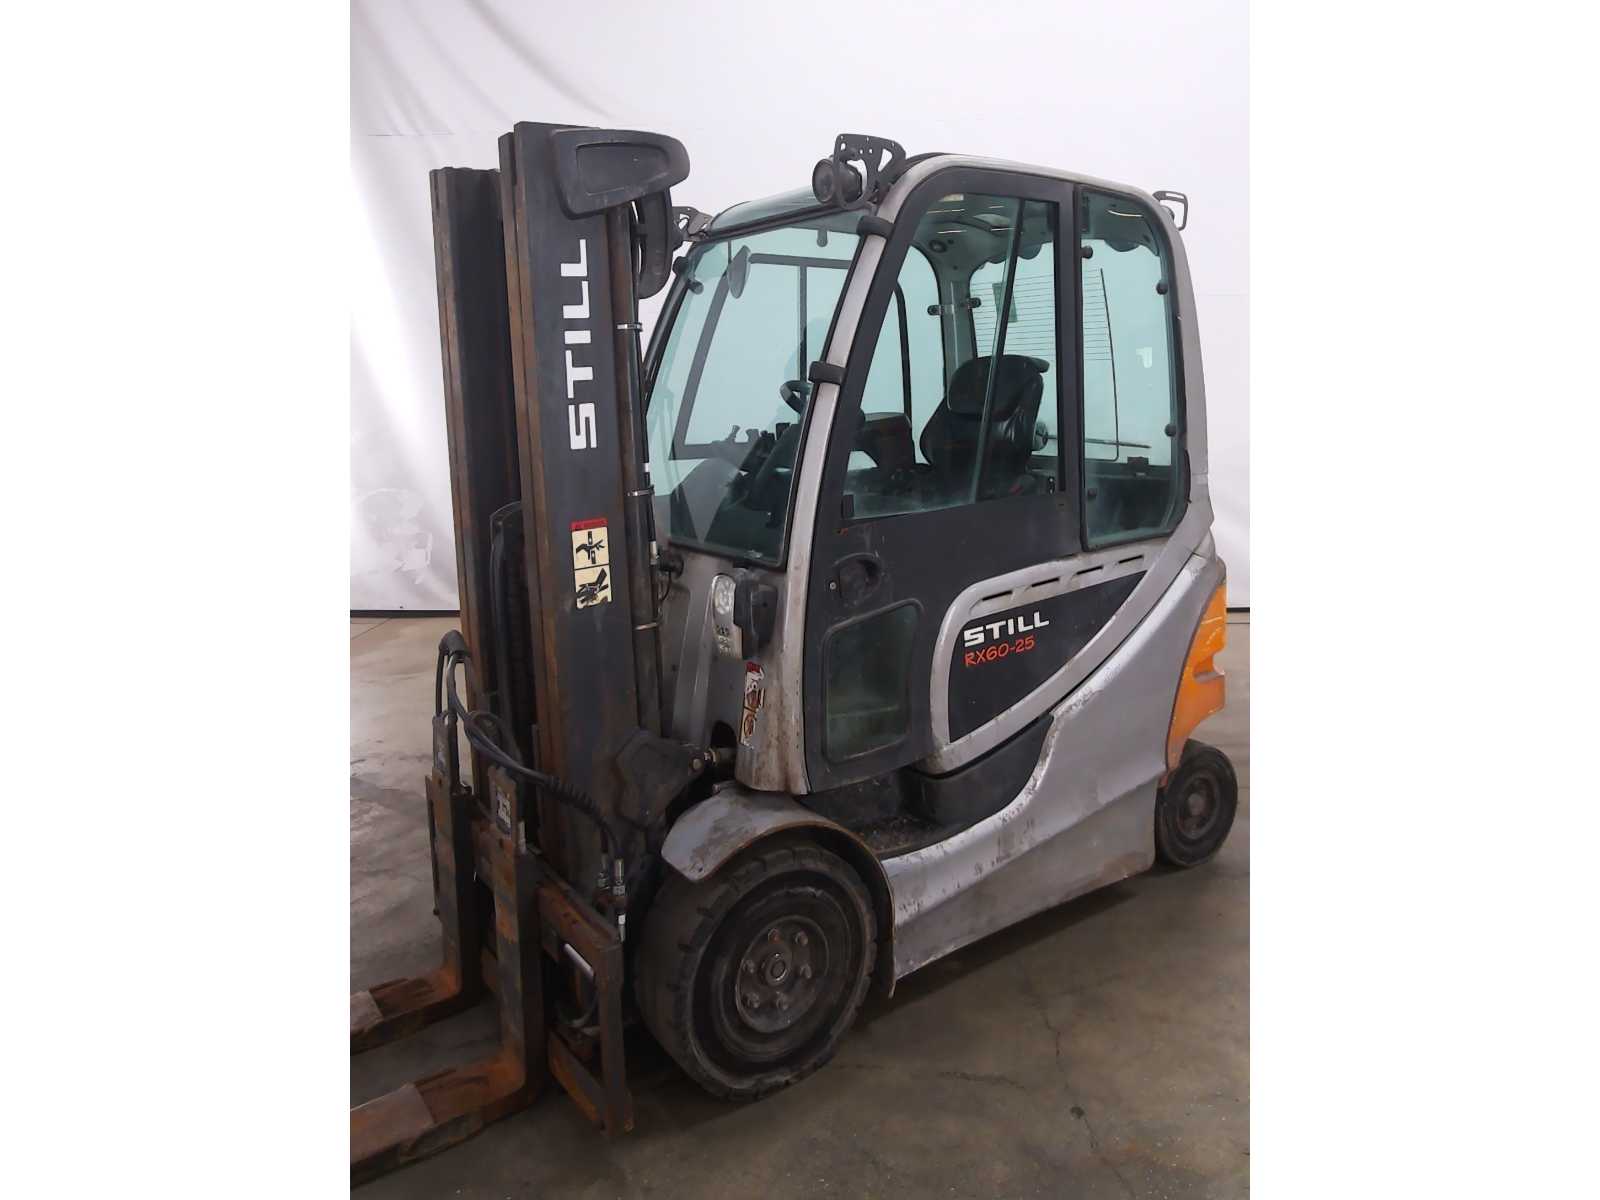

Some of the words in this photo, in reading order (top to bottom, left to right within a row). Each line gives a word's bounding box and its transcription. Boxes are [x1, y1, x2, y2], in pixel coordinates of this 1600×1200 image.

[560, 238, 598, 450] STILL
[963, 611, 1050, 648] STILL
[964, 635, 1036, 668] RX60-25
